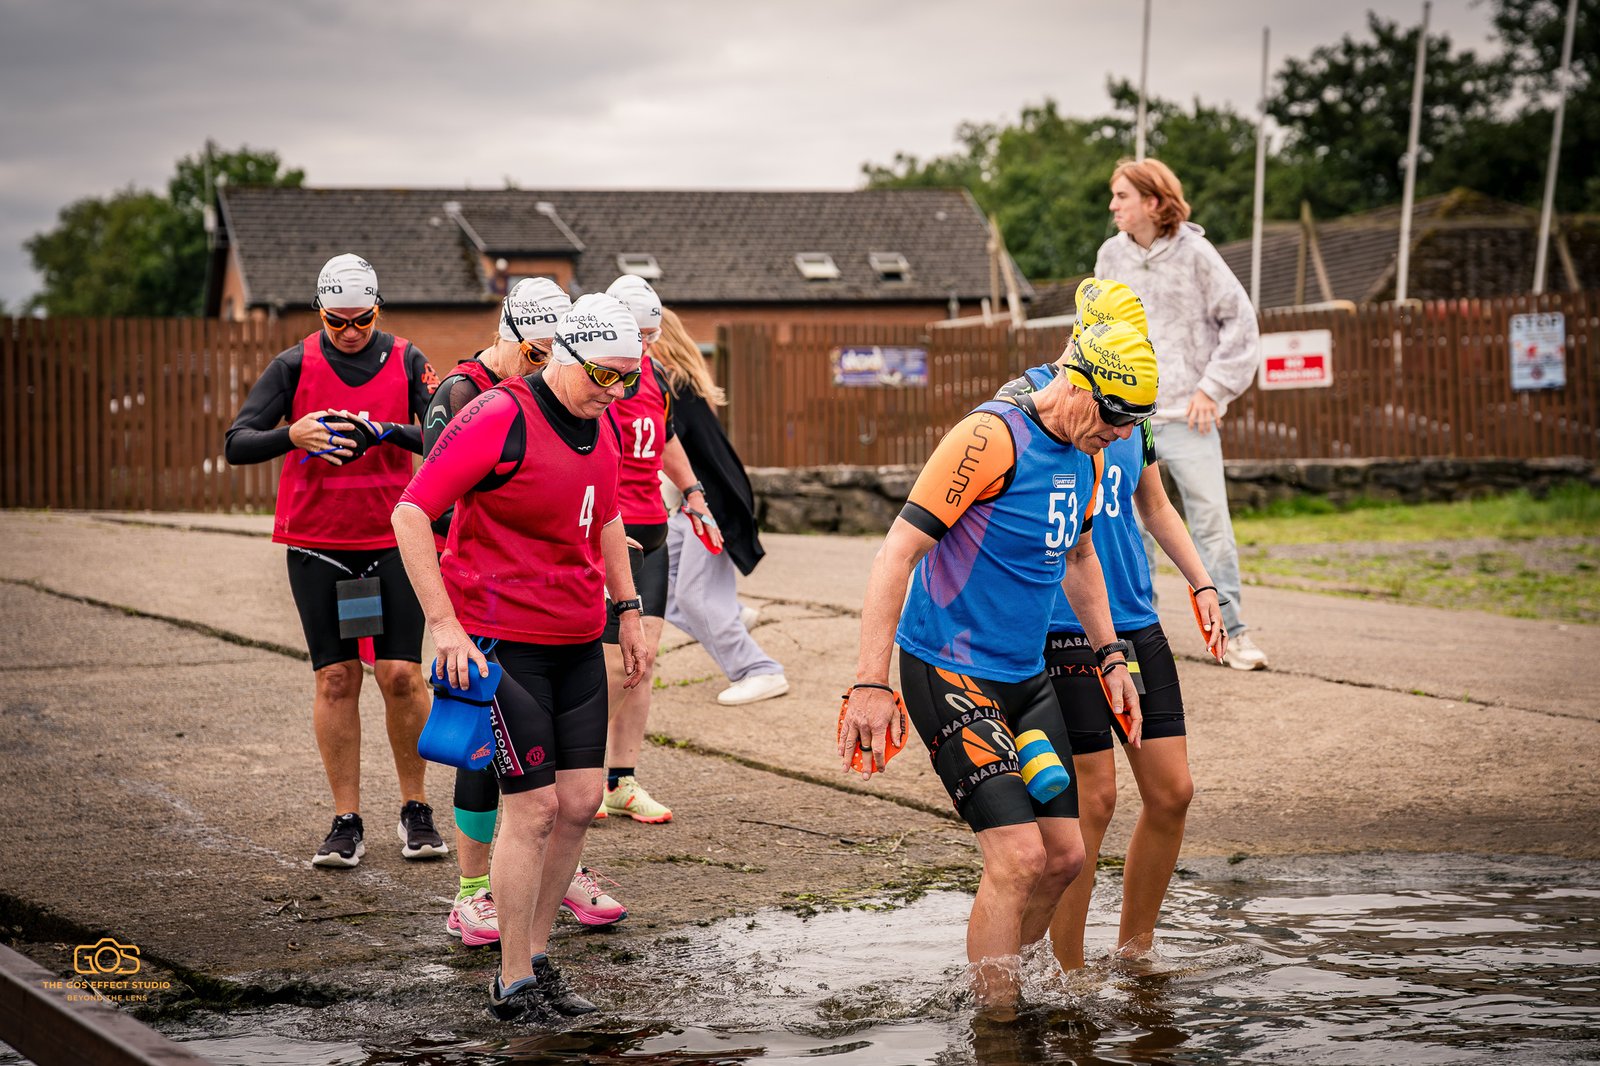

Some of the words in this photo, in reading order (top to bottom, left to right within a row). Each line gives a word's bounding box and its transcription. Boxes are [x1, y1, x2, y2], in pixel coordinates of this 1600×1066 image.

[428, 424, 462, 464] SOUTH
[461, 389, 501, 424] COAST
[632, 417, 656, 459] 12
[578, 485, 596, 539] 4
[1045, 491, 1078, 549] 53
[1051, 637, 1091, 650] NABA
[941, 708, 1001, 737] NABAIJI
[494, 728, 515, 771] COAST
[495, 749, 507, 775] CLUB
